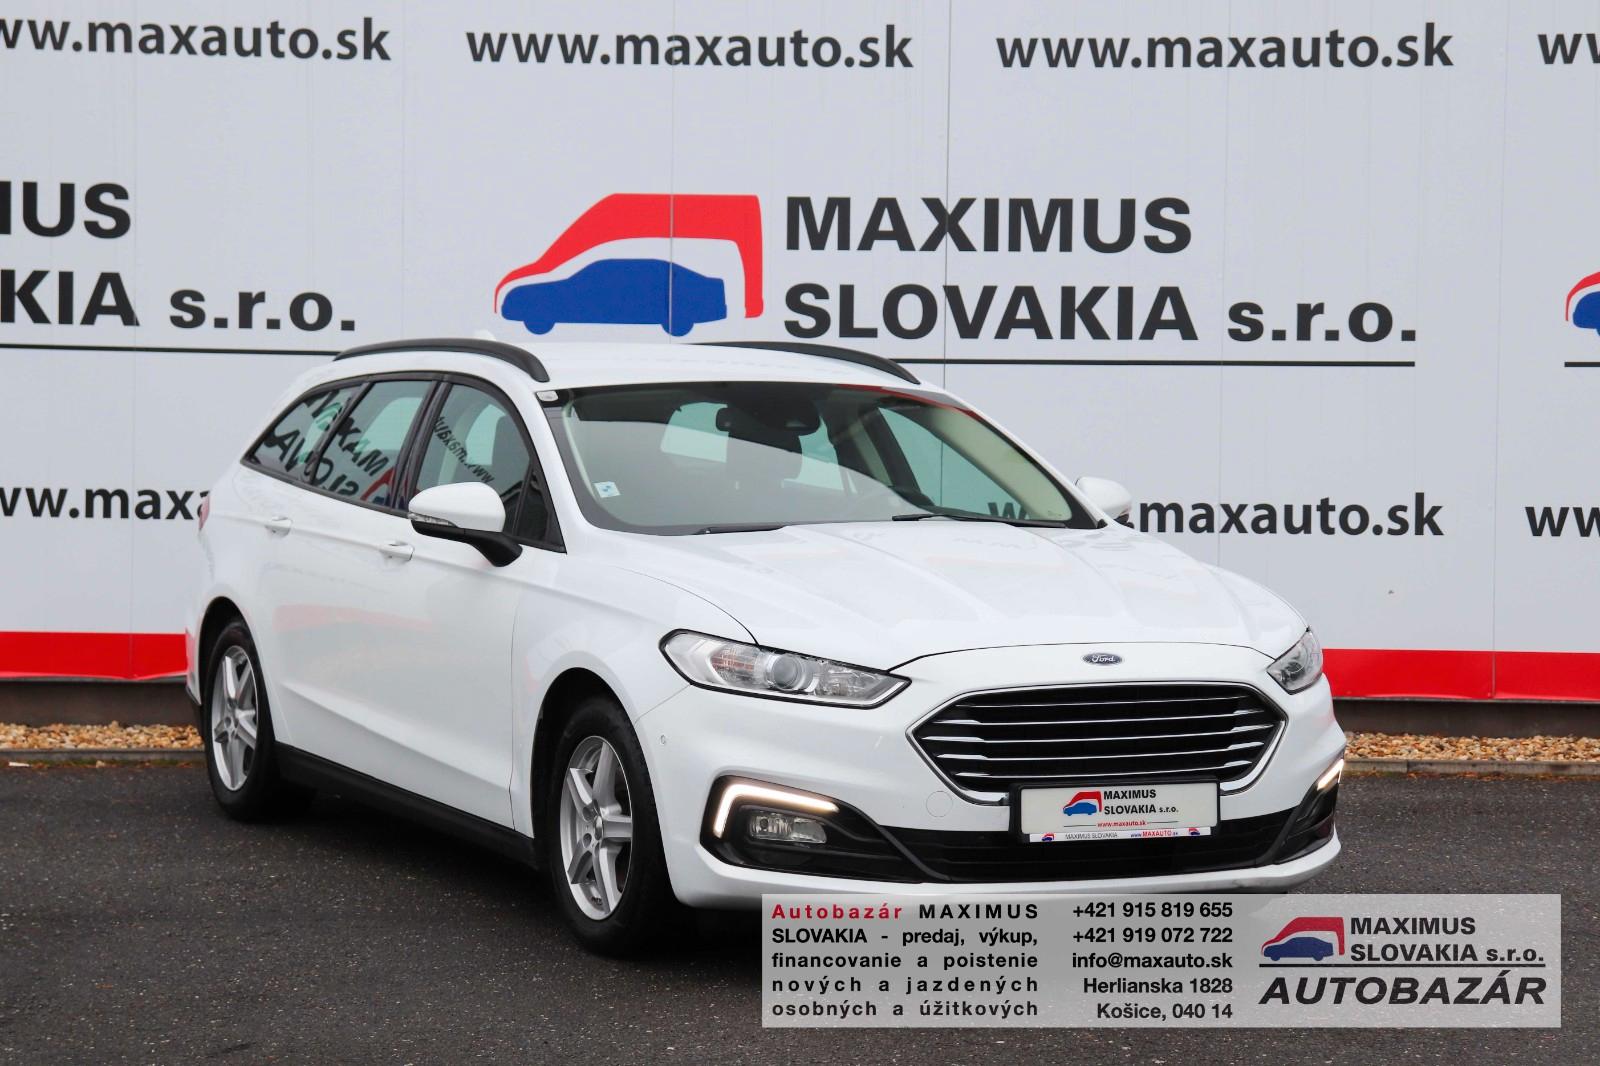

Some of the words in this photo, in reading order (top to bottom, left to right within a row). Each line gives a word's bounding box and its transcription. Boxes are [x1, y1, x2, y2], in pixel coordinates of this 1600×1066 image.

[466, 24, 913, 68] www.maxauto.sk
[997, 22, 1454, 68] www.maxauto.sk
[0, 181, 131, 239] US
[787, 196, 1192, 254] MAXIMUS
[0, 269, 140, 327] KIA
[170, 290, 355, 332] s.r.o.
[785, 283, 1199, 342] SLOVAKIA
[1228, 302, 1416, 343] s.r.o.
[1091, 654, 1116, 663] Ford
[1103, 788, 1157, 800] MAXIMUS
[1104, 804, 1157, 815] SLOVAKIA
[1097, 820, 1147, 828] www.maxauto.sk
